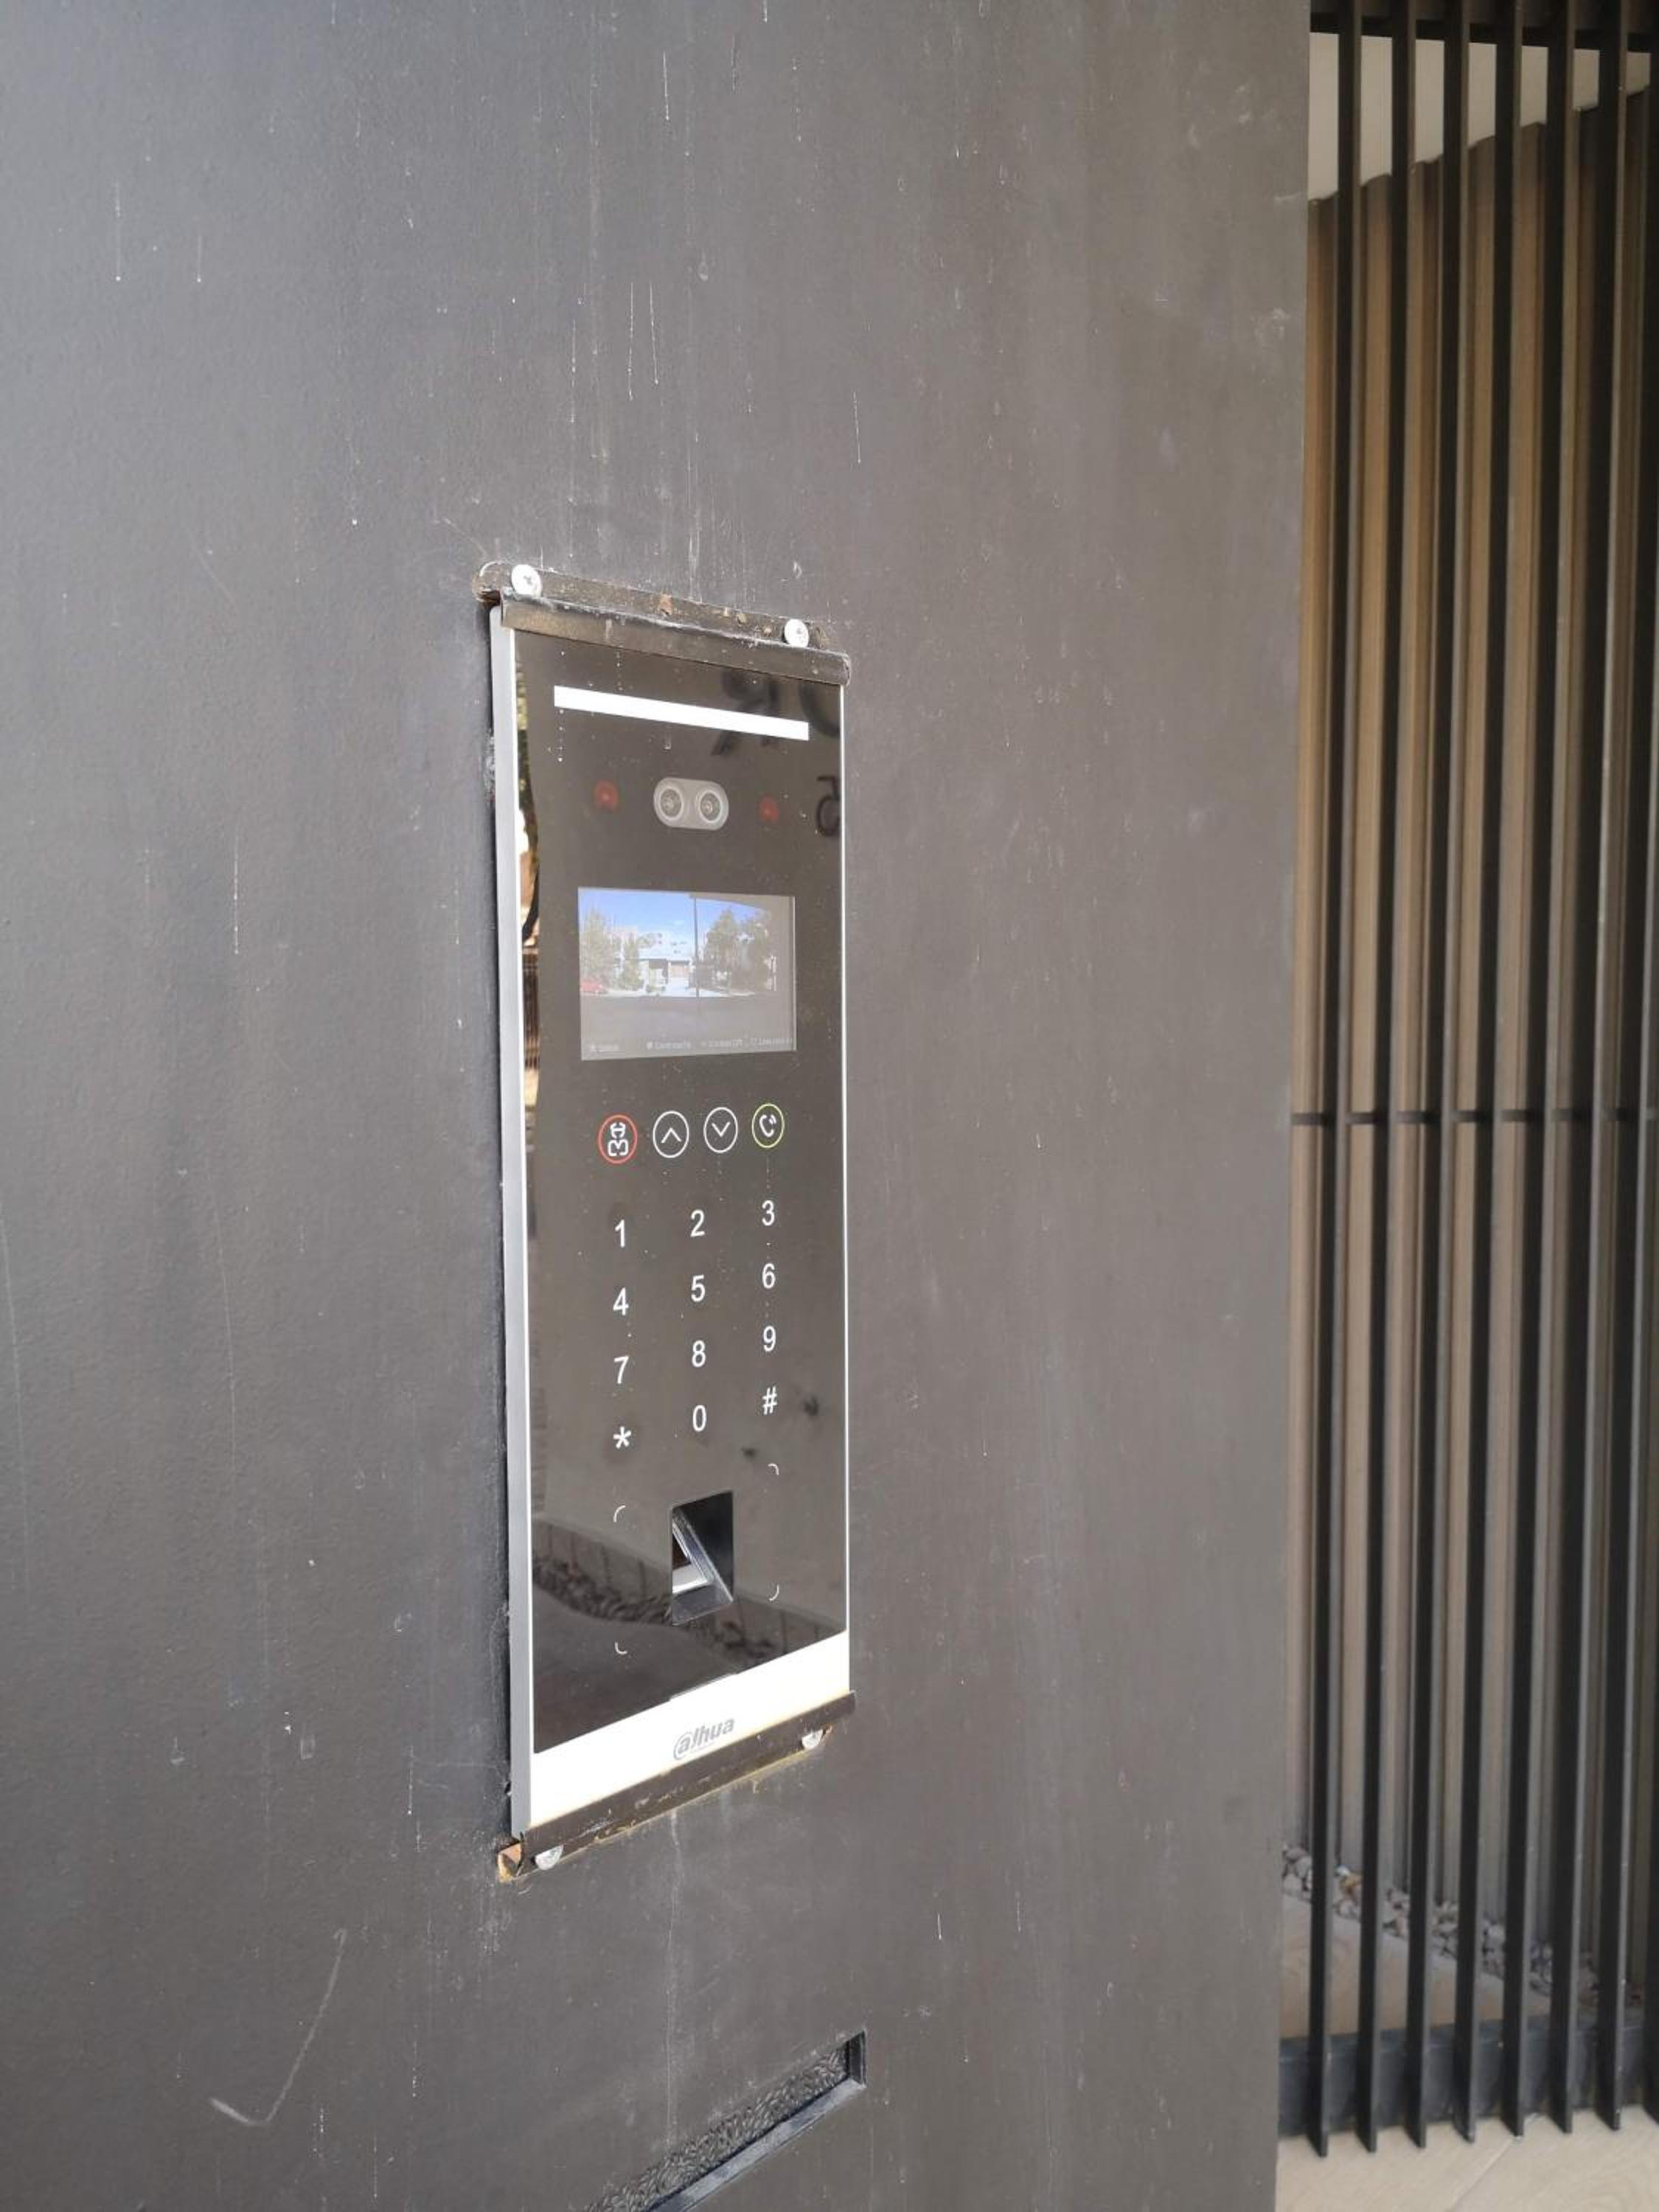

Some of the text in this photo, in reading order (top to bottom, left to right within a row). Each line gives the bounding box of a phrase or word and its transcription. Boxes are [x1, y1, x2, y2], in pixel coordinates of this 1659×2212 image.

[614, 1200, 776, 1248] 1 2 3
[613, 1263, 776, 1315] 4 5 6
[613, 1326, 777, 1384] 7 8 9
[692, 1405, 707, 1433] 0
[762, 1386, 778, 1415] #
